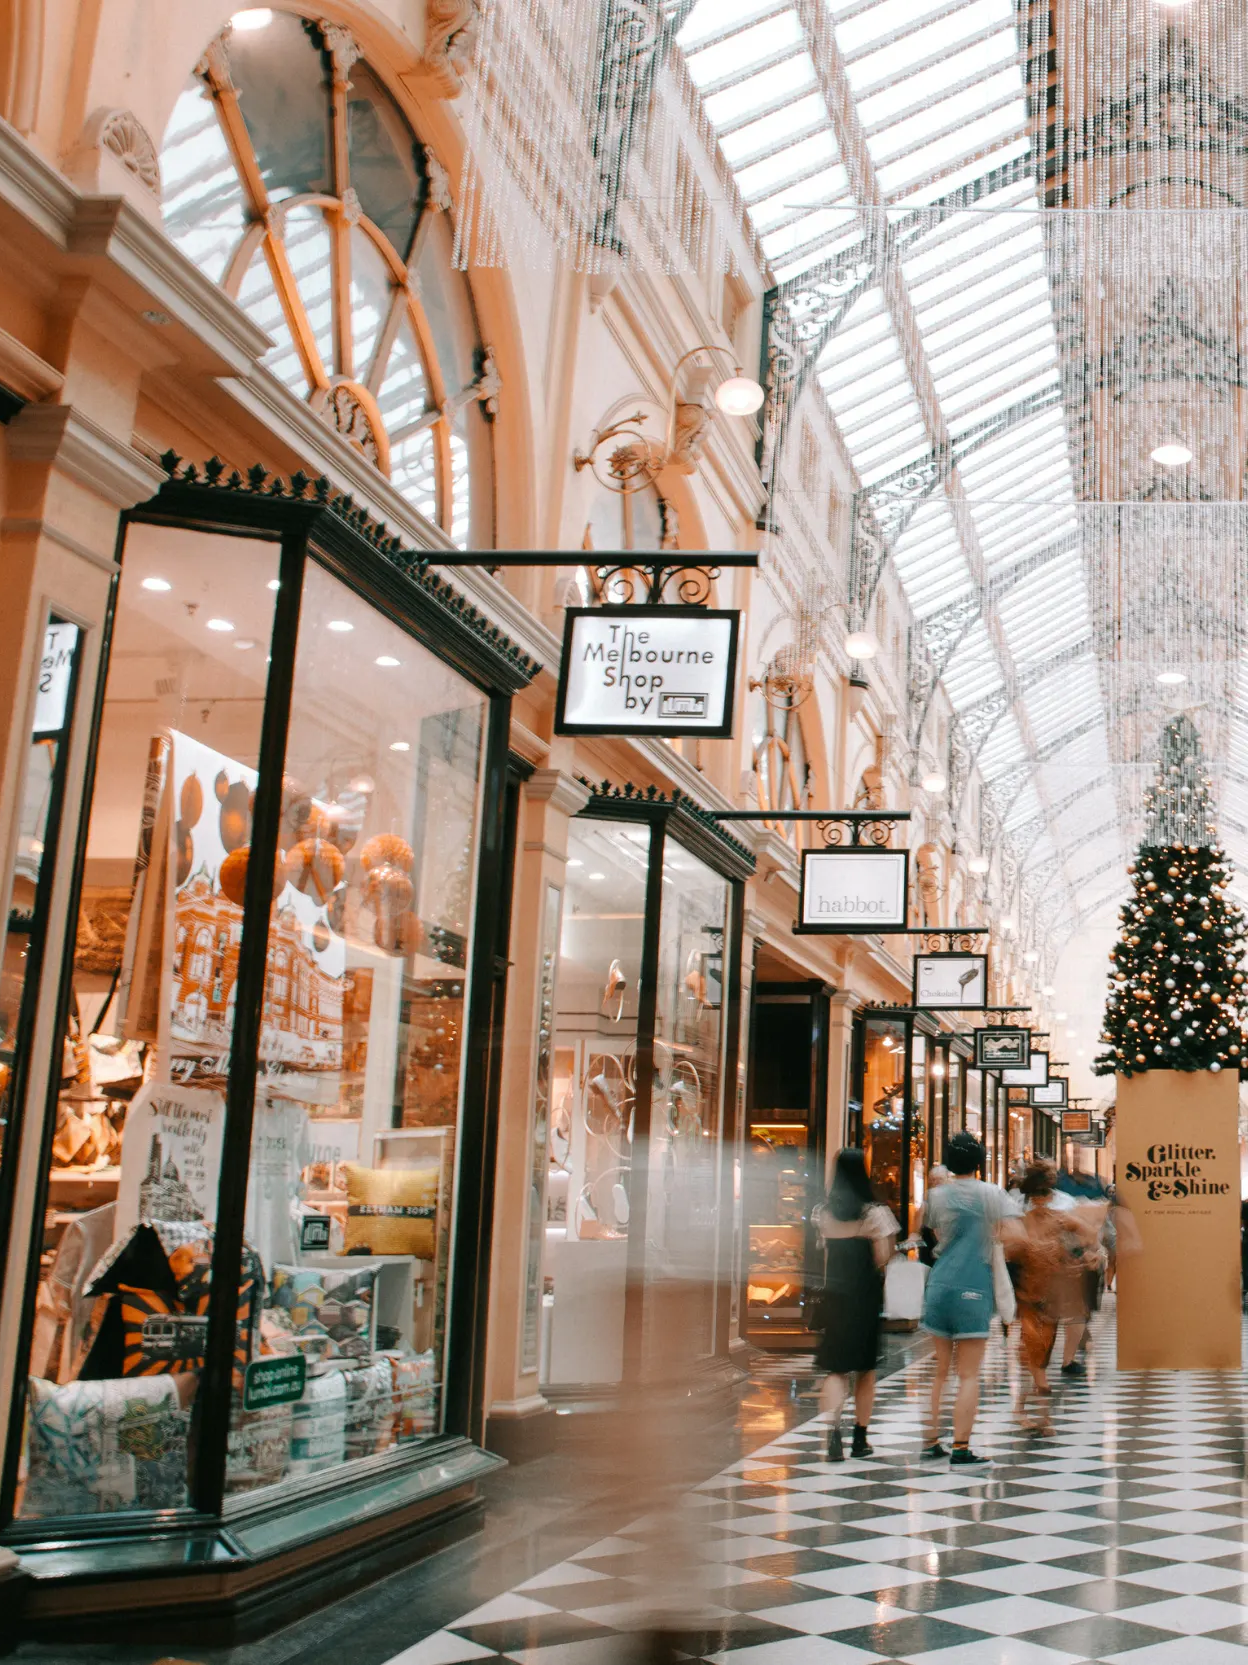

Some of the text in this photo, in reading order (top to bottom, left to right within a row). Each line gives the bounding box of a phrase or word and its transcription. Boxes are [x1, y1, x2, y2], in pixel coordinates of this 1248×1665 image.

[609, 624, 650, 646] The
[583, 643, 714, 664] Melbourne
[603, 666, 663, 692] Shop
[625, 692, 654, 714] by
[1125, 1161, 1201, 1182] Sparkle
[1172, 1178, 1230, 1199] Shine
